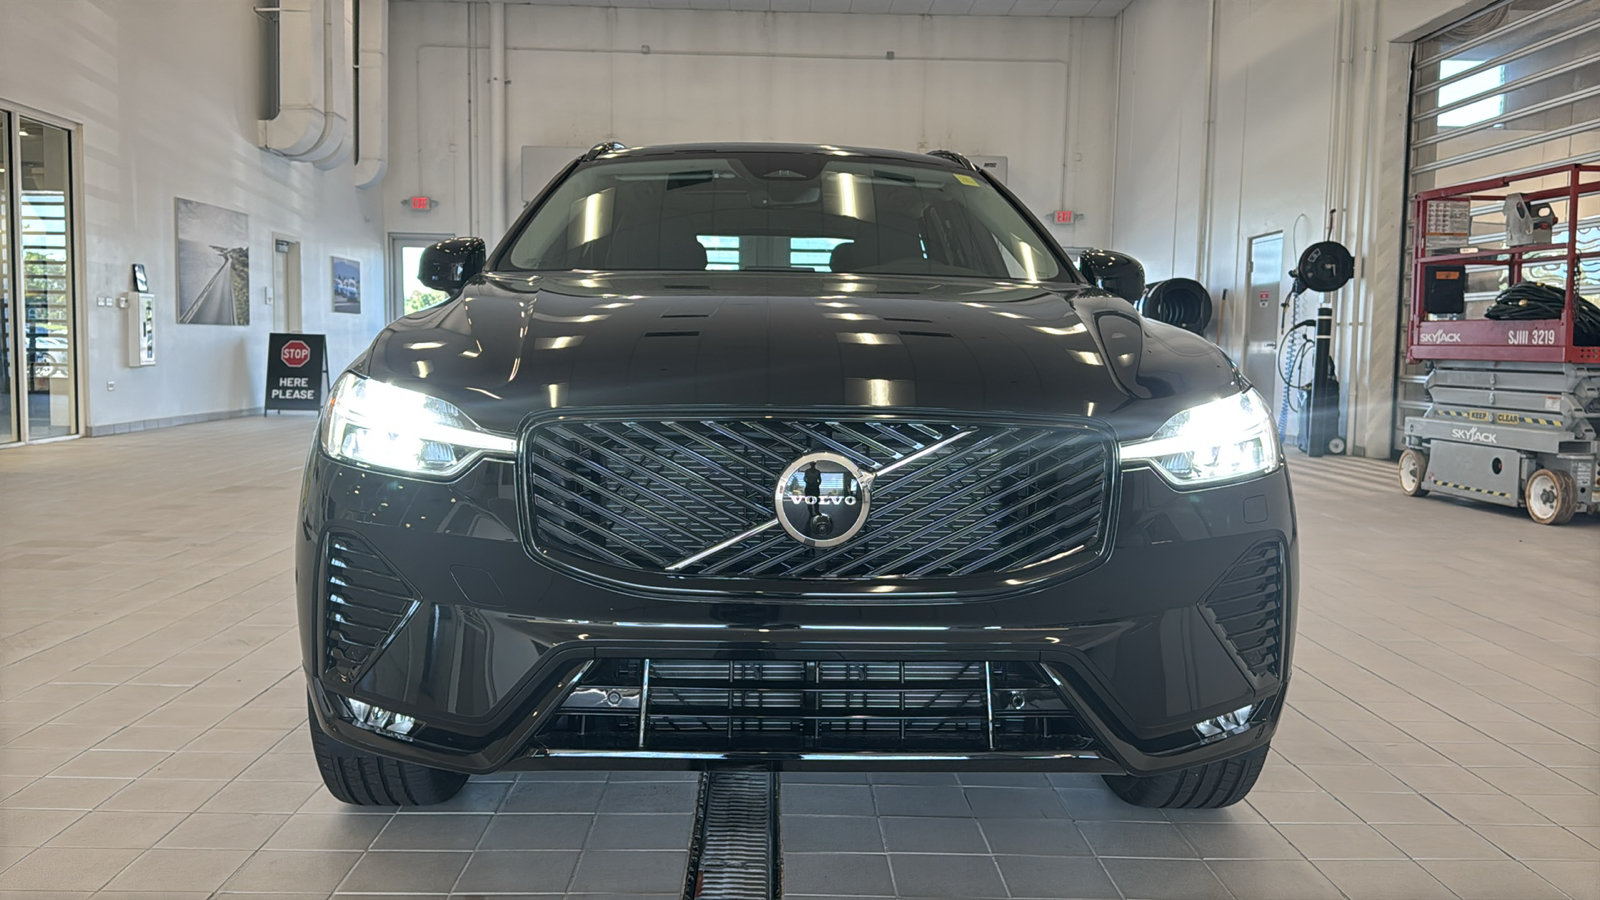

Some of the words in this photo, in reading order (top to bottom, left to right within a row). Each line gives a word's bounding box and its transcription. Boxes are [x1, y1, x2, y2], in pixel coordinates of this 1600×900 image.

[1420, 329, 1461, 344] SKYJACK
[1532, 330, 1555, 344] 3219
[283, 348, 308, 359] STOP
[279, 377, 309, 387] HERE
[271, 389, 315, 399] PLEASE
[1471, 411, 1487, 419] KEEP
[1497, 413, 1518, 422] CLEAR
[1451, 426, 1497, 443] SKYJACK
[789, 495, 857, 505] VOLVO
